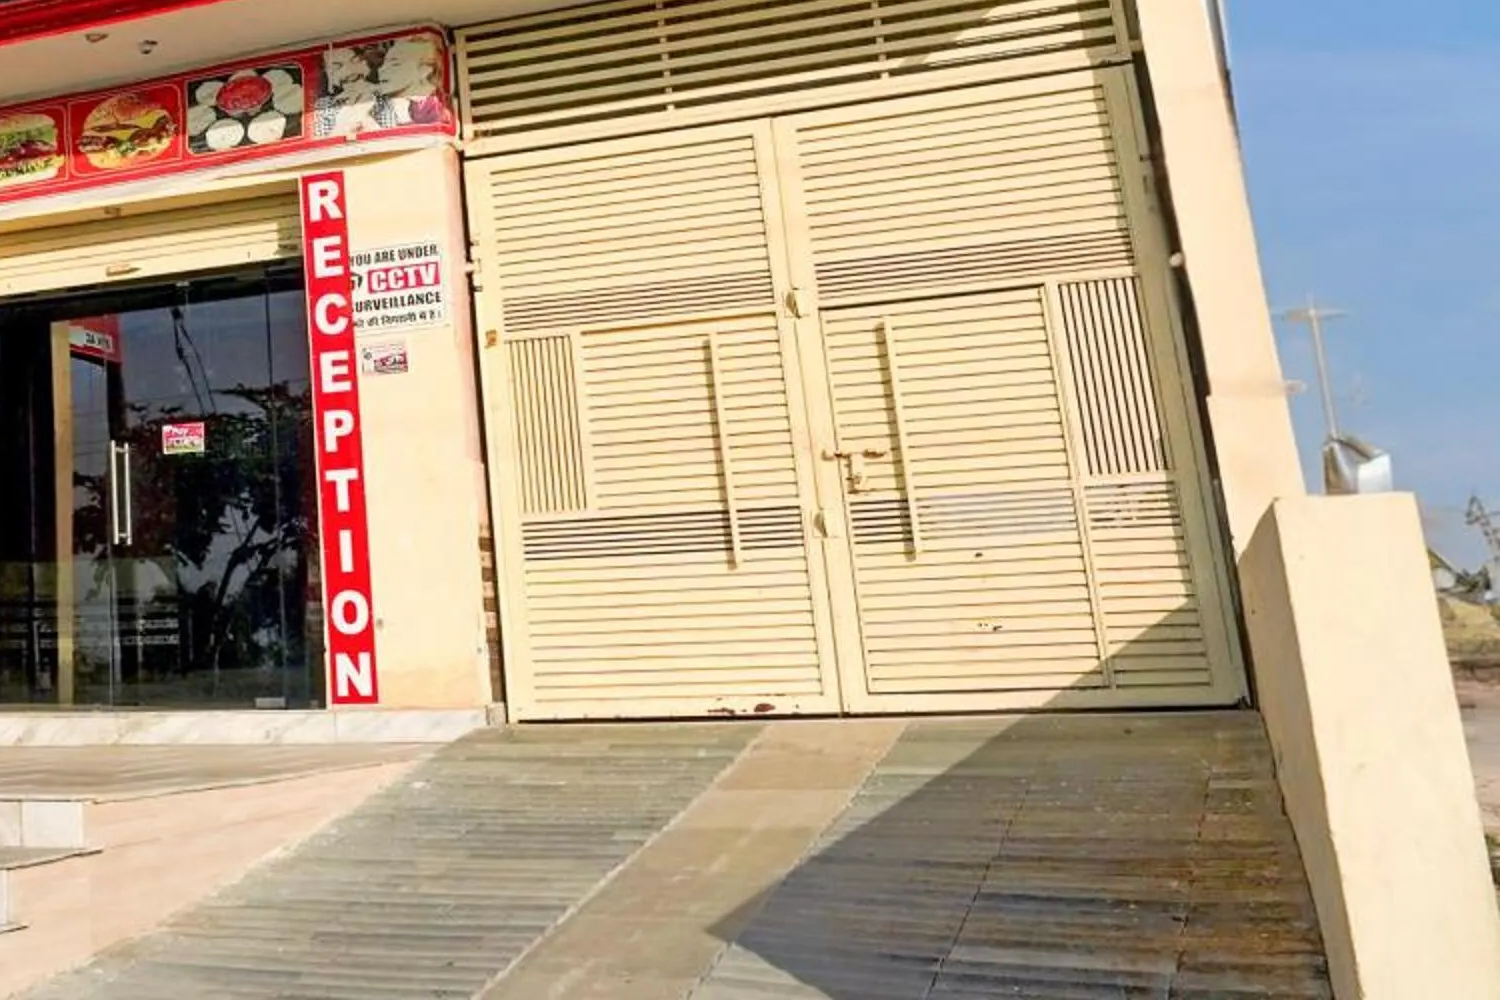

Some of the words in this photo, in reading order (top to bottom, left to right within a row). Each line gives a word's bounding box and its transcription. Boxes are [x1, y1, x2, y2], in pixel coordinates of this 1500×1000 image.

[374, 249, 395, 264] ARE
[397, 244, 438, 261] UNDER
[371, 262, 437, 292] CCTV
[351, 291, 441, 313] URVEILLANCE
[307, 180, 374, 697] RECEPTION
